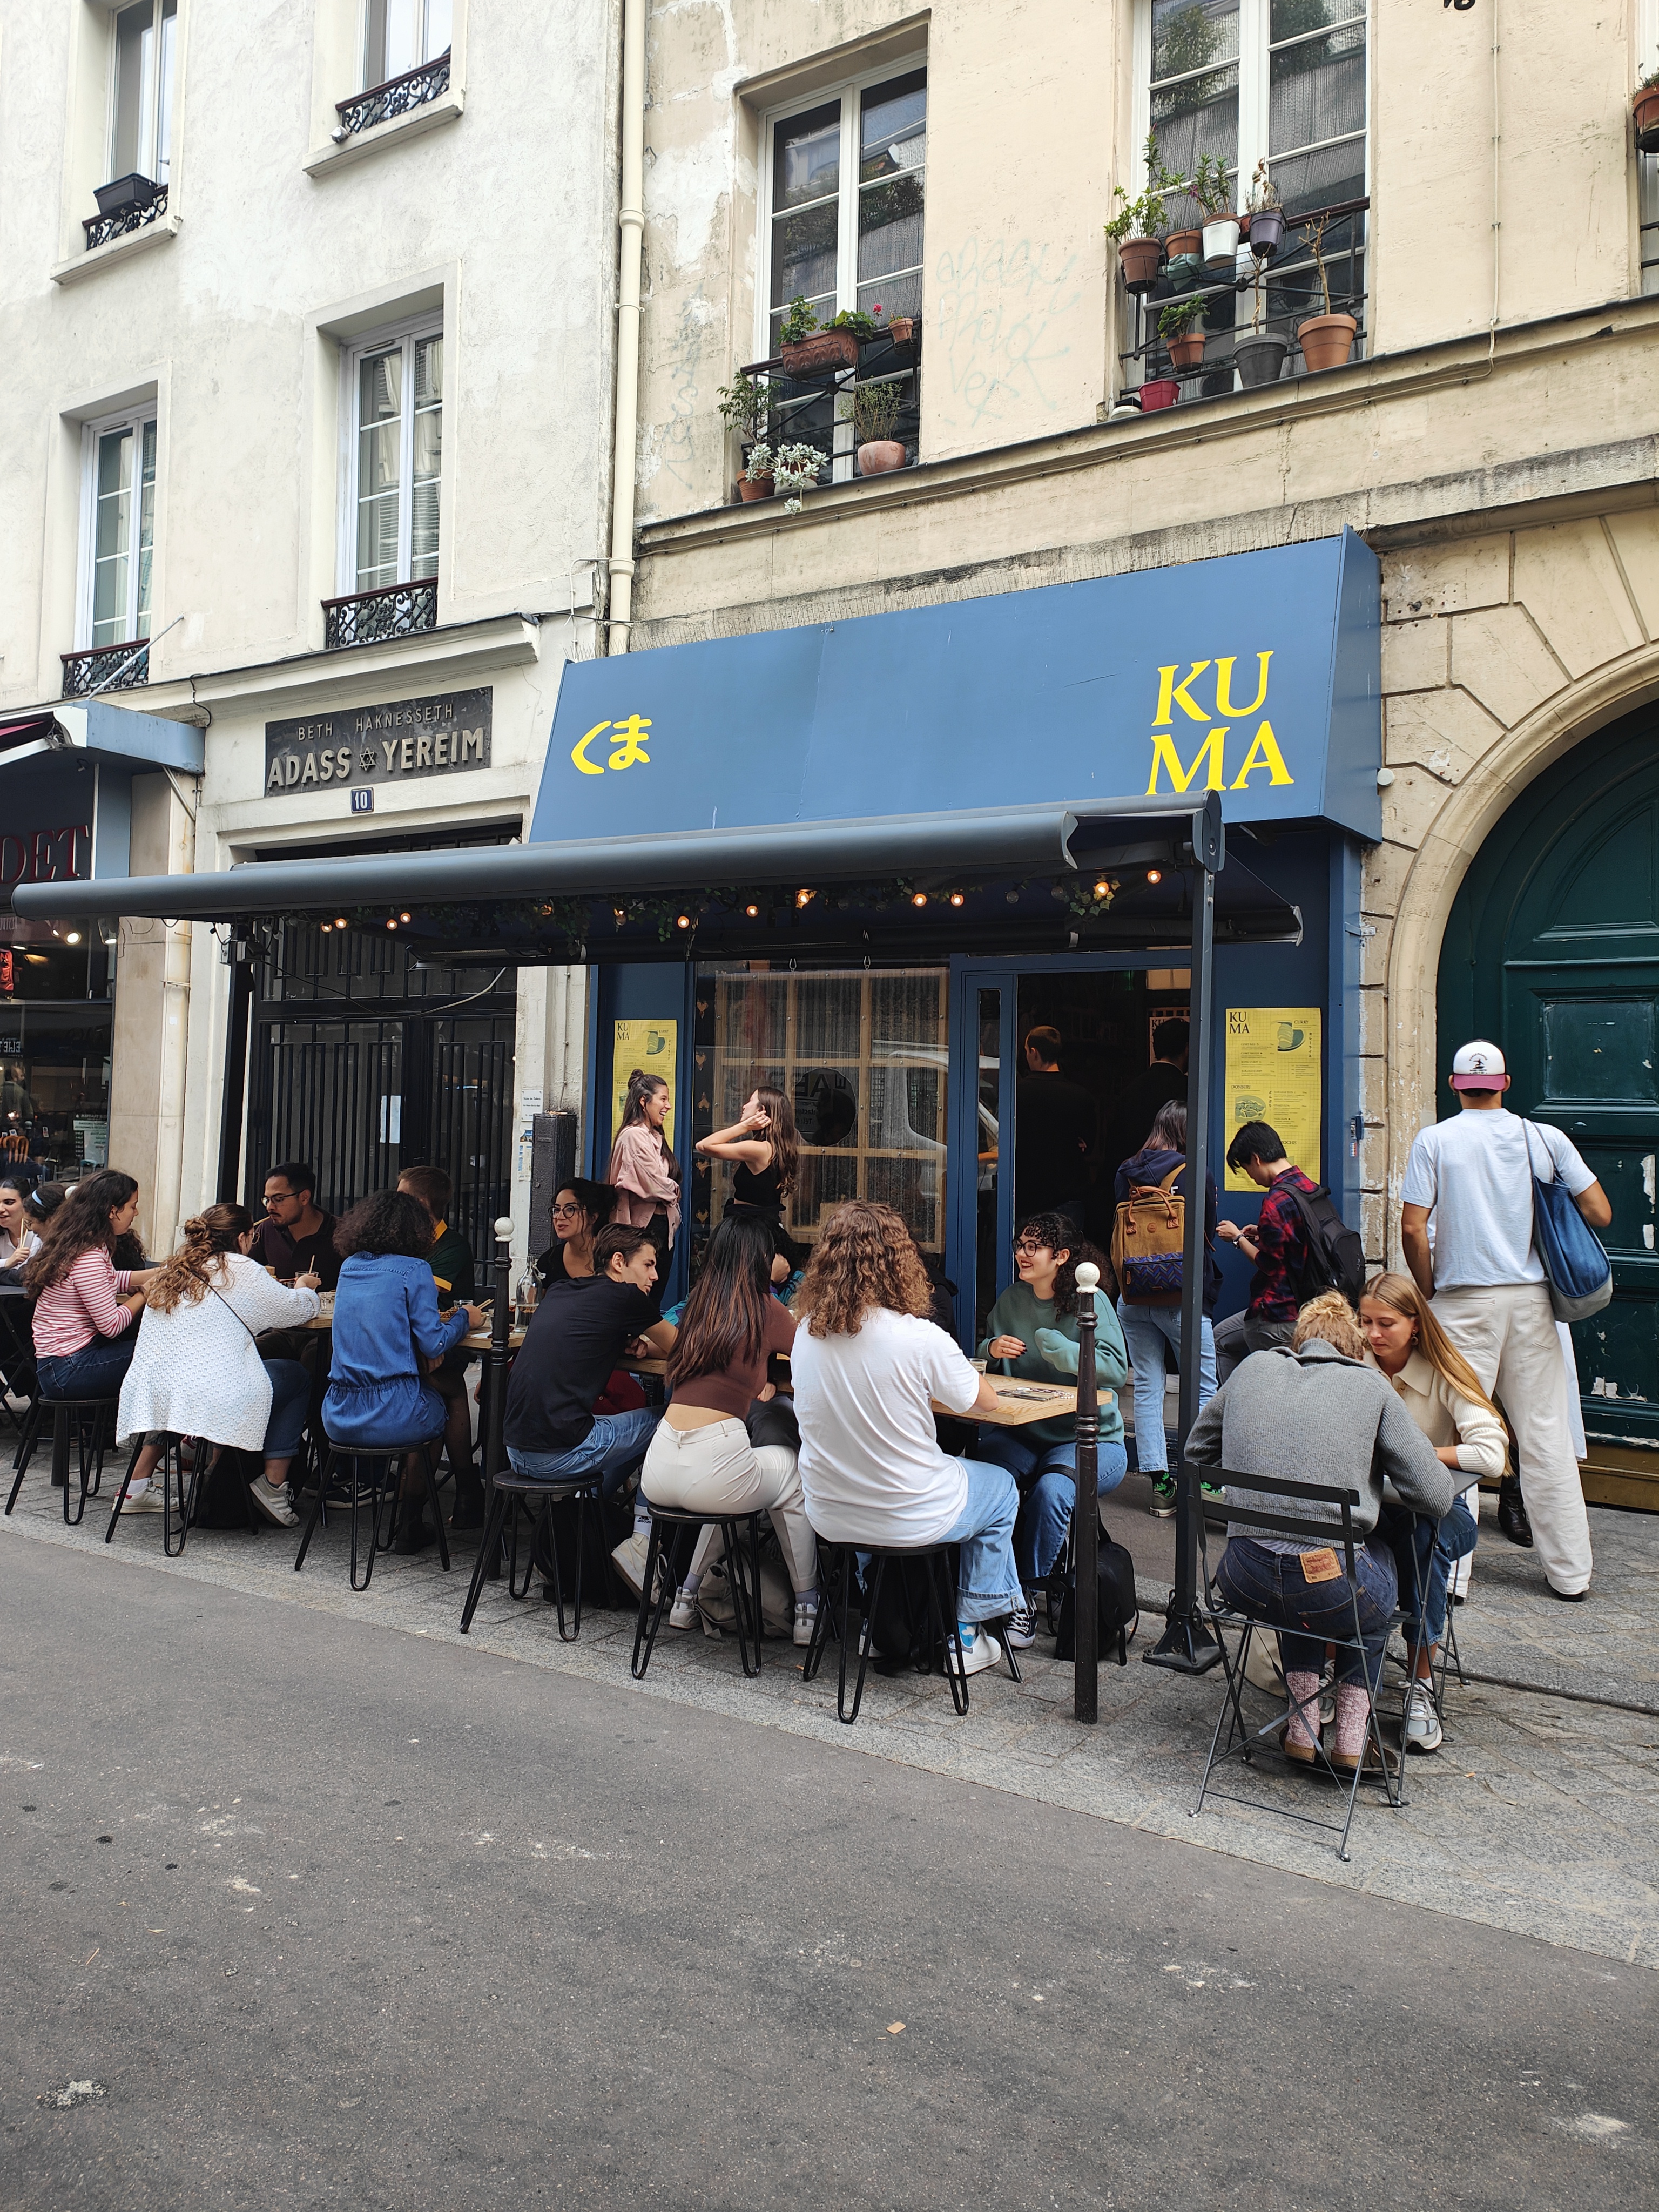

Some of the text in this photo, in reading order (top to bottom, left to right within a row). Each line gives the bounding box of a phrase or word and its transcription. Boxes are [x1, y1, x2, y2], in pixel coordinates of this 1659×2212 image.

[1151, 650, 1274, 726] KU
[298, 703, 453, 741] BETH HAKNESSETH
[267, 726, 484, 788] ADASS YEREIM
[571, 713, 652, 774] くま
[1144, 720, 1294, 796] MA
[354, 791, 368, 810] 10
[617, 1022, 629, 1031] KU
[1229, 1011, 1247, 1022] KU
[1229, 1023, 1250, 1034] MA
[617, 1032, 629, 1040] MA
